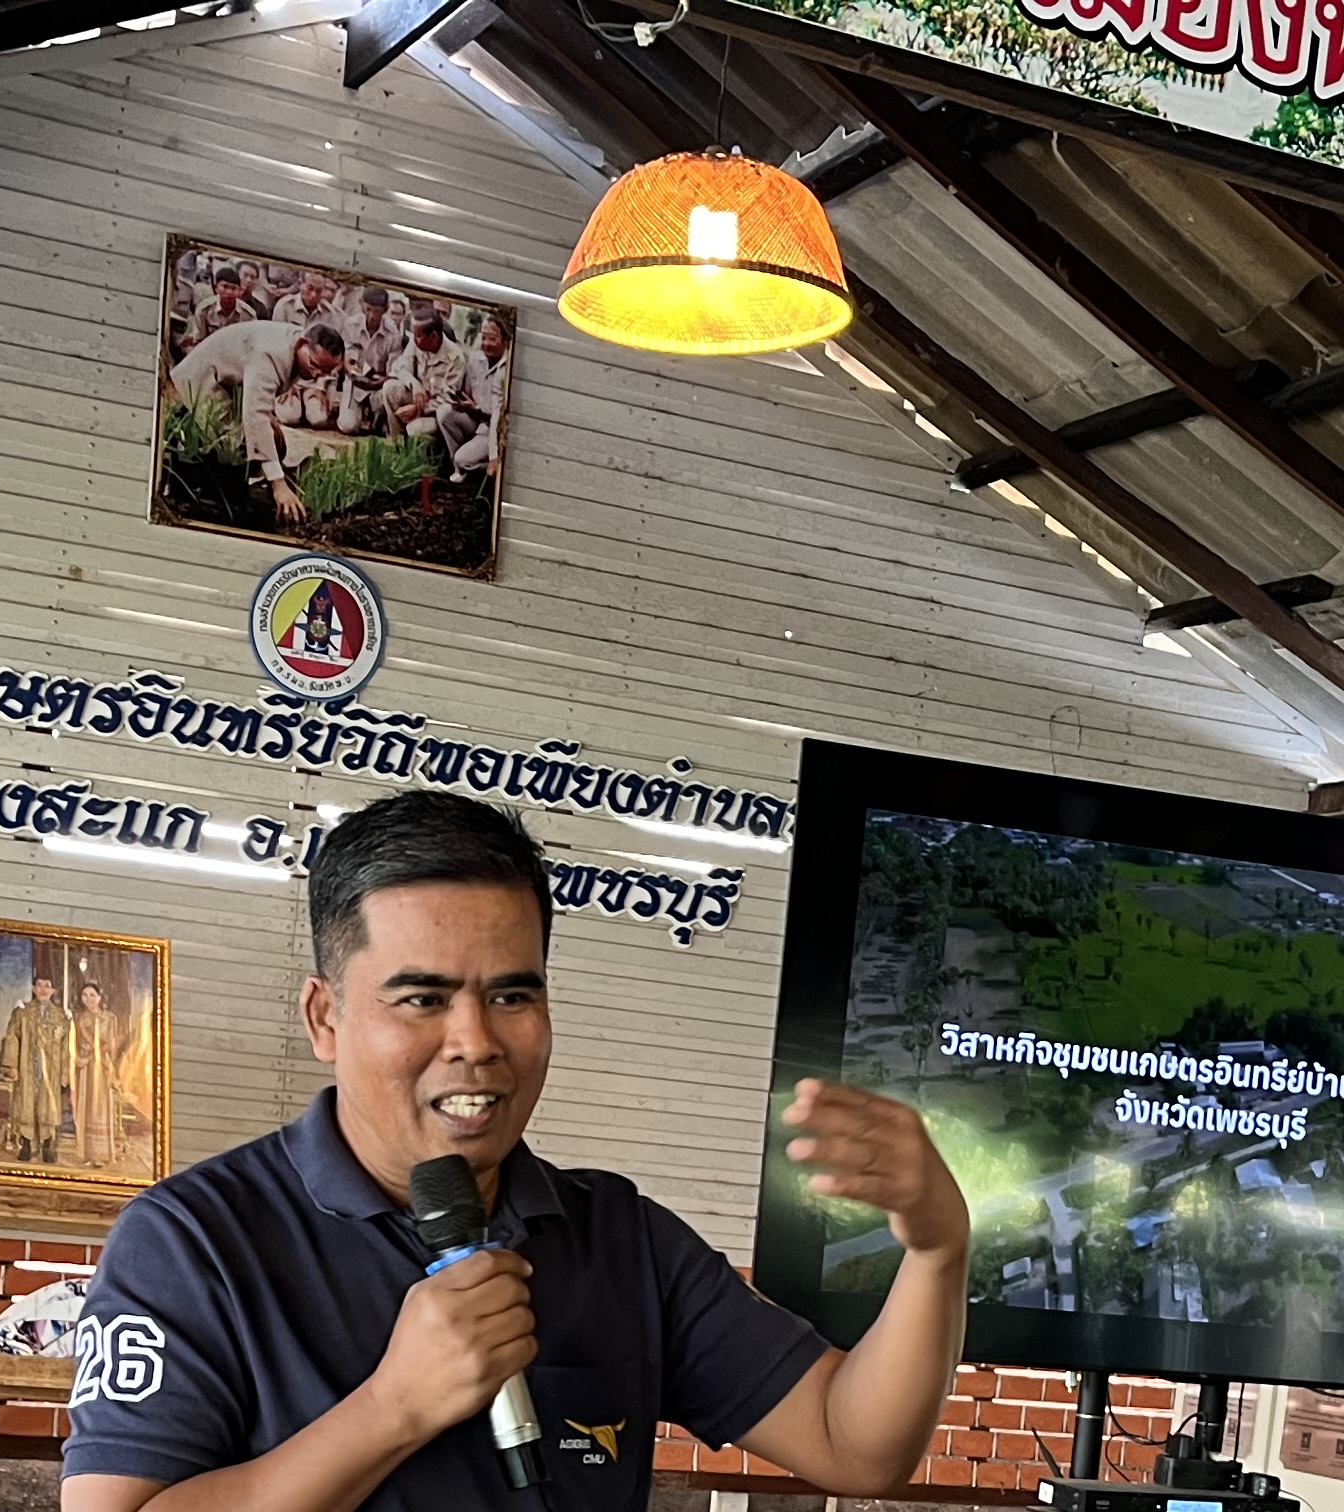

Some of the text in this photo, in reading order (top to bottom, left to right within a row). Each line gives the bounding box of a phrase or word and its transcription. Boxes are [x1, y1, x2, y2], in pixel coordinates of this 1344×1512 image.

[540, 856, 746, 948] พชรบุรี
[1114, 1090, 1308, 1149] จังหวัดเพชรบุรี
[68, 1315, 167, 1408] 26
[582, 1453, 606, 1465] CMU
